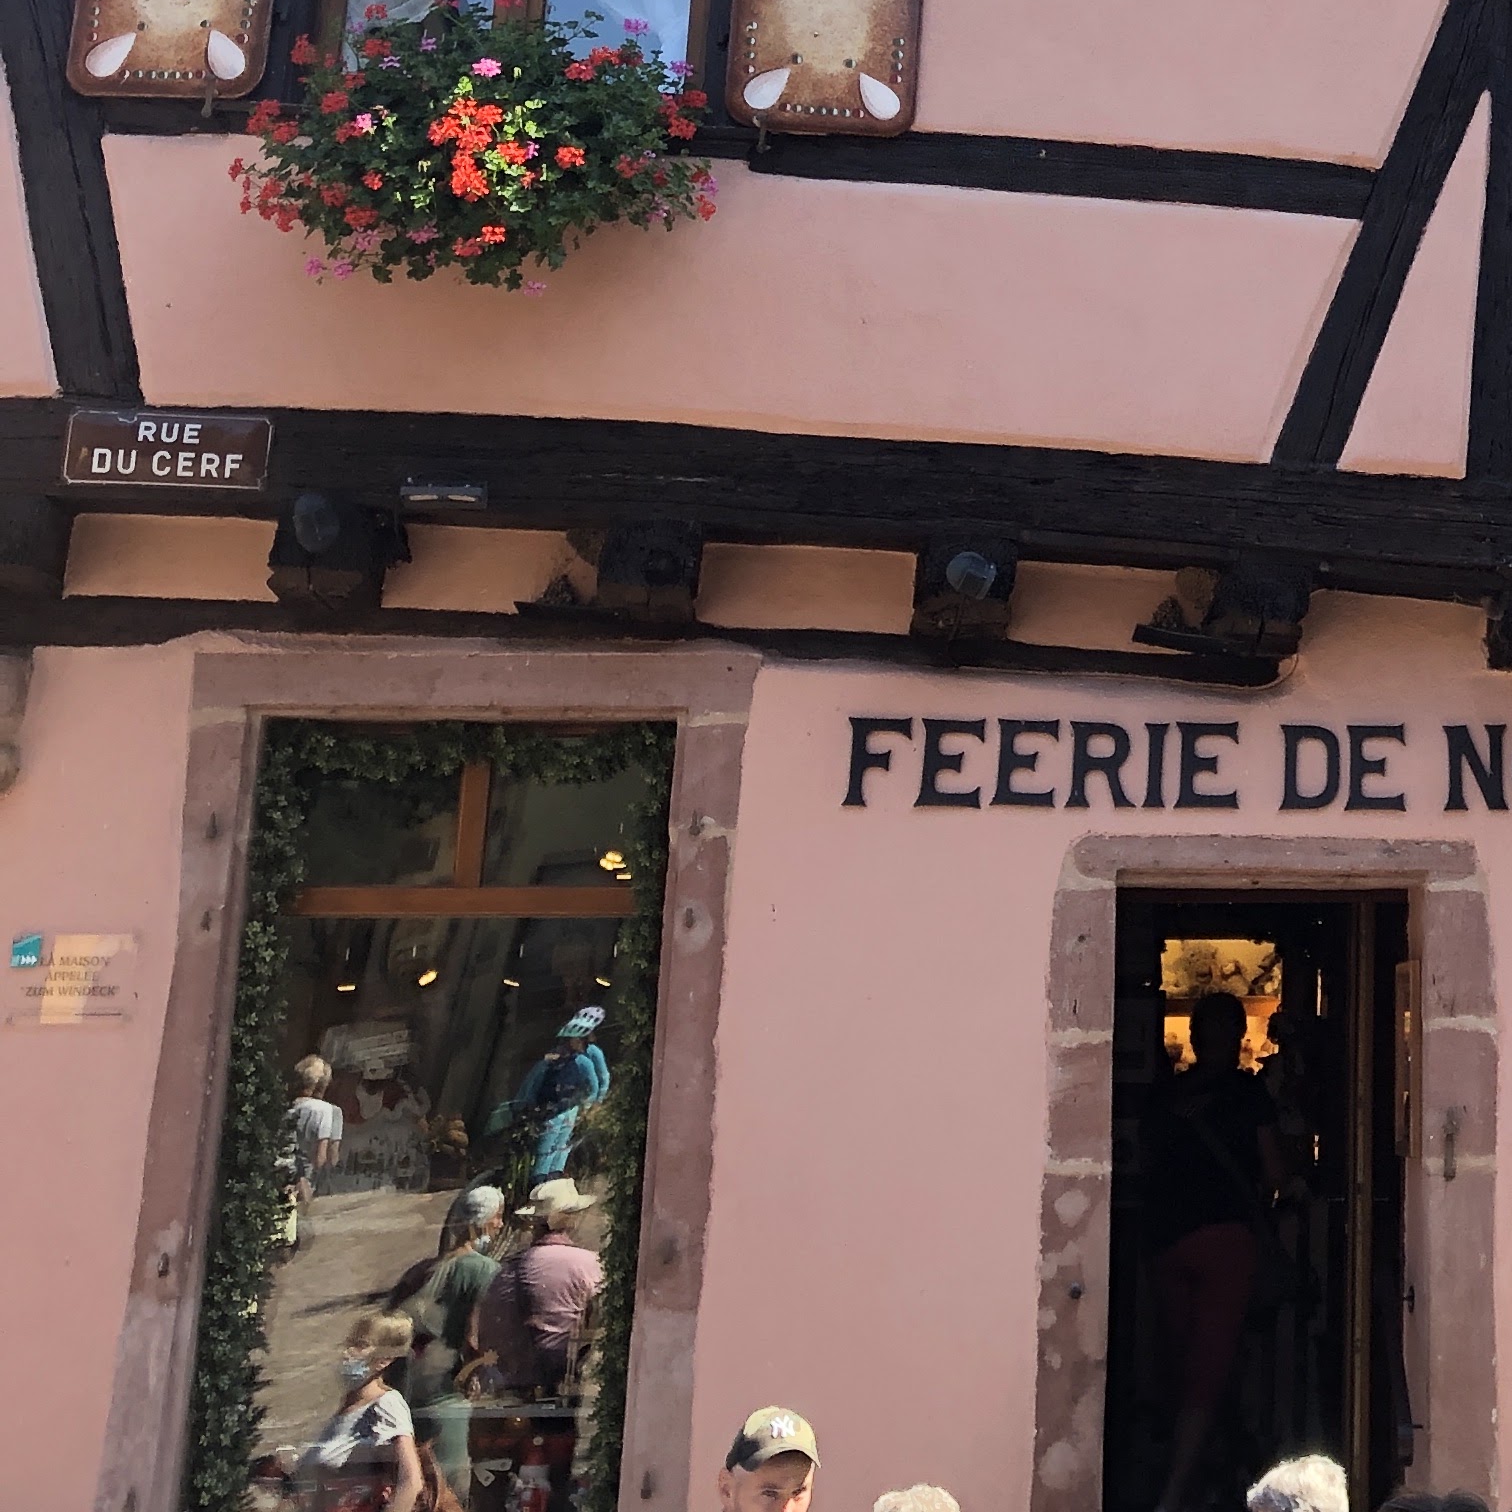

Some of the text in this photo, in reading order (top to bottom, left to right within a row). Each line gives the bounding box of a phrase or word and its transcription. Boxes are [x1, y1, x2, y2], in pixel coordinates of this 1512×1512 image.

[137, 421, 202, 444] RUE
[91, 448, 244, 479] DU CERF
[841, 716, 1240, 810] FEERIE
[1278, 721, 1407, 812] DE
